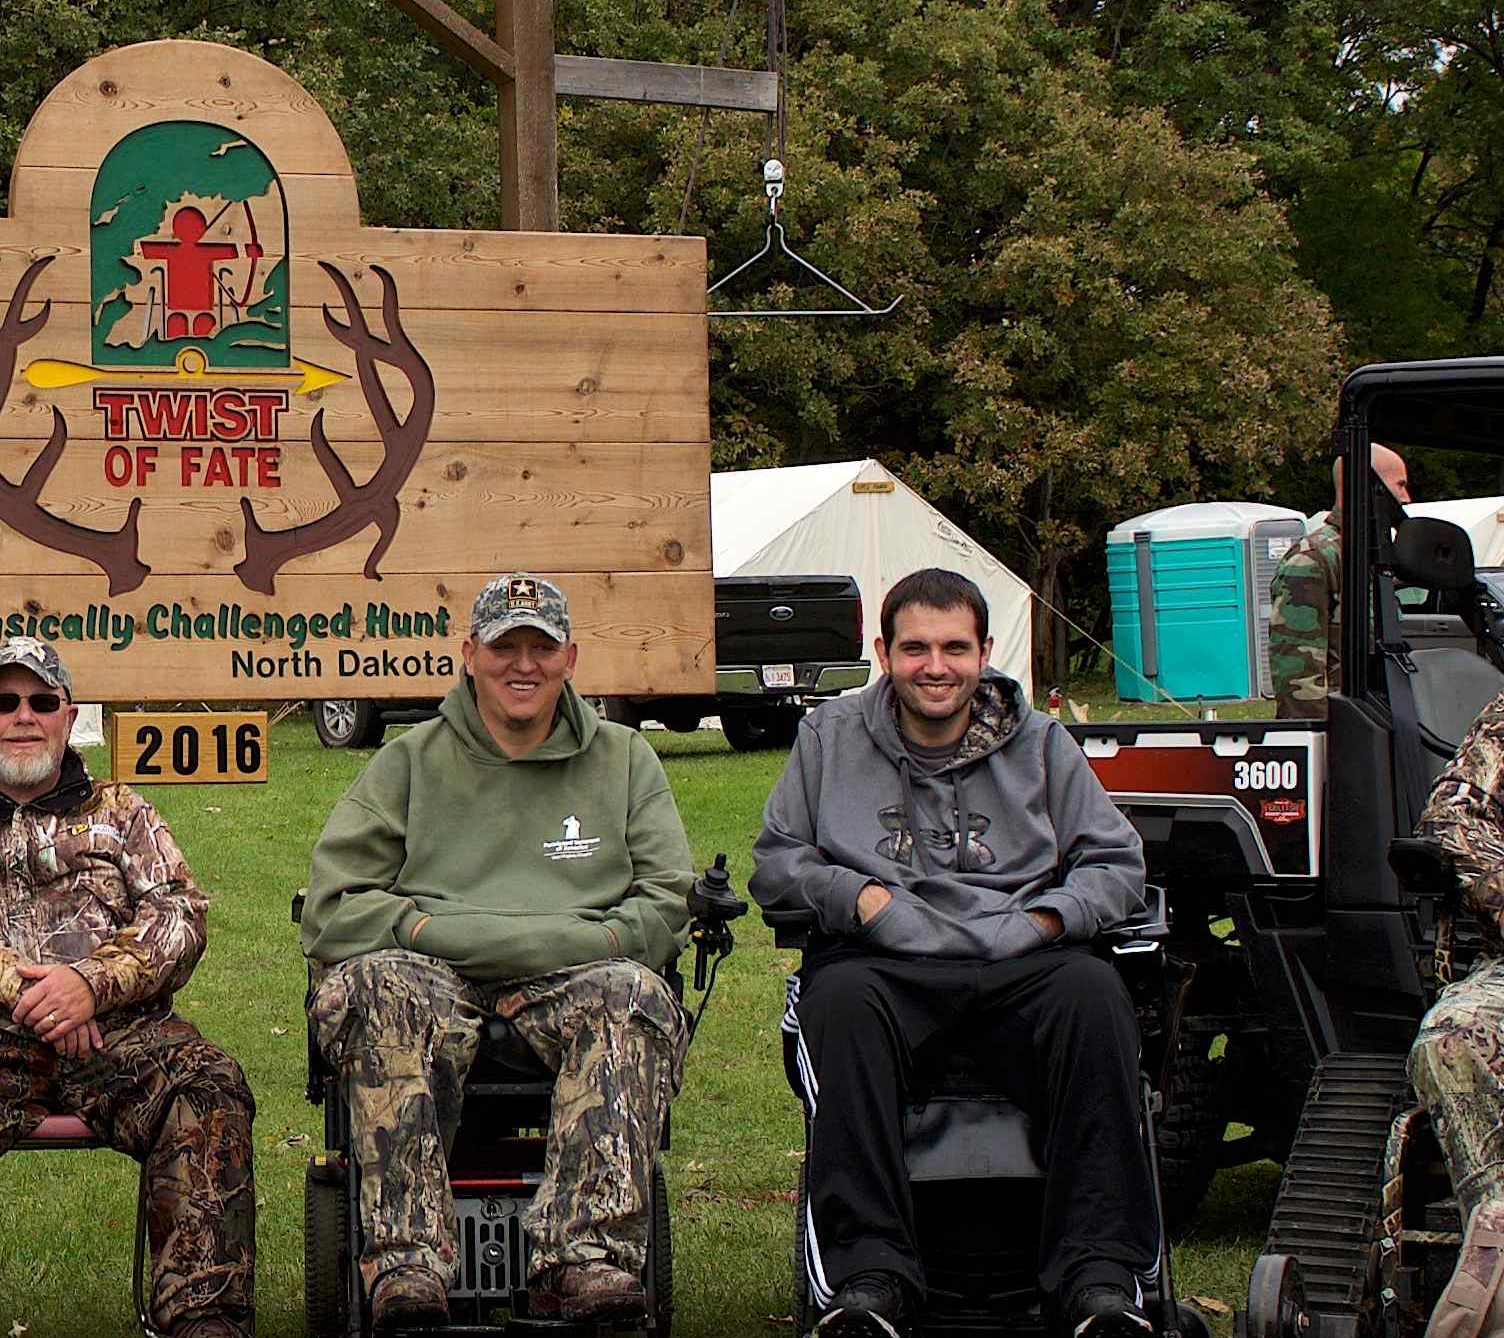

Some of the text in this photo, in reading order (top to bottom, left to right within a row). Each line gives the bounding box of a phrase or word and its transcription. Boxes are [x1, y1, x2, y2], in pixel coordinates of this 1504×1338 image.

[95, 389, 288, 441] TWIST
[105, 445, 282, 487] OF FATE
[146, 602, 353, 650] Challenged
[365, 602, 451, 639] Hunt
[231, 649, 455, 678] North Dakota
[134, 723, 262, 776] 2016
[1234, 760, 1298, 790] 3600
